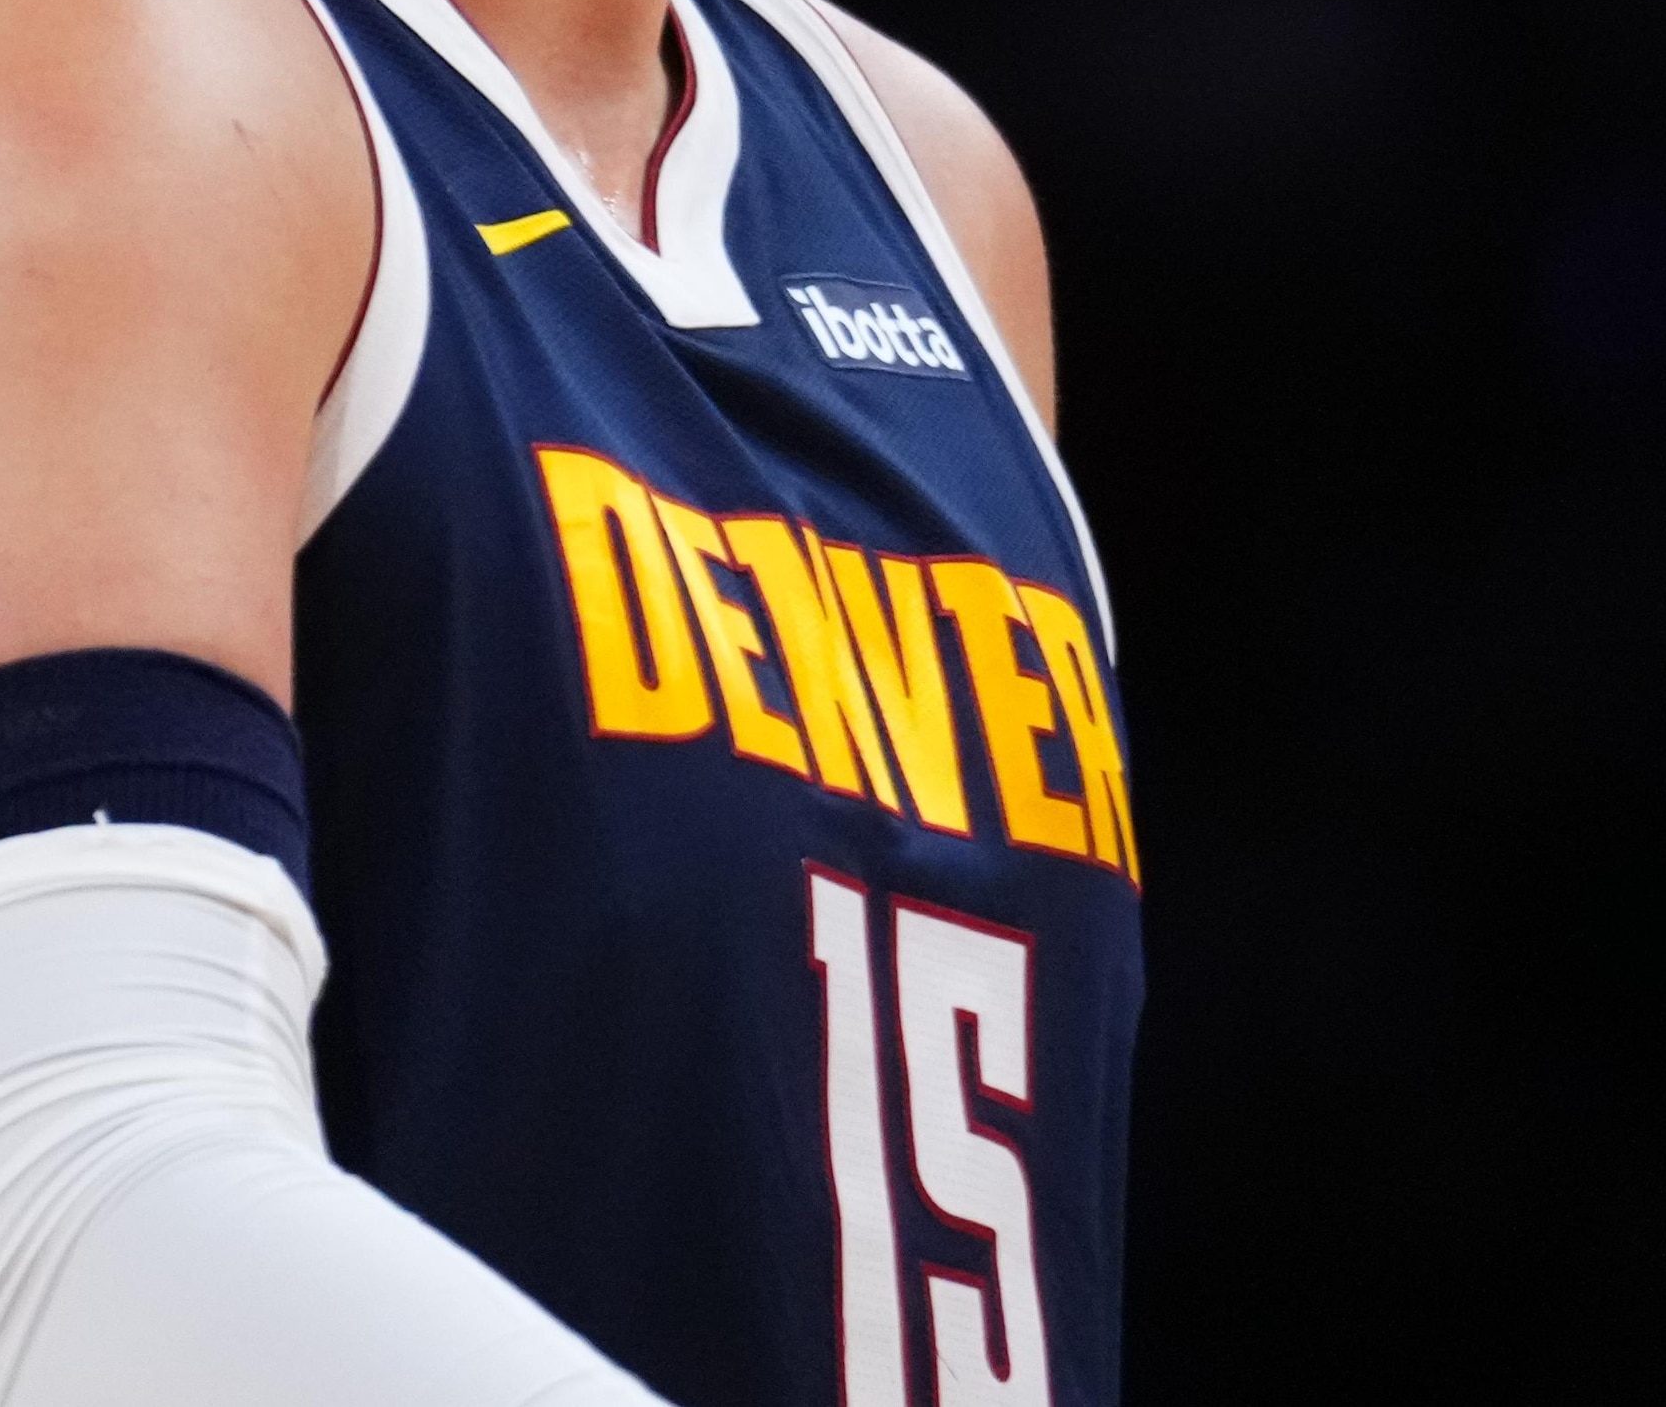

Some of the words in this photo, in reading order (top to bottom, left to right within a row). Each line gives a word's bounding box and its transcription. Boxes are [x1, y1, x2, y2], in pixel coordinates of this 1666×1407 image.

[786, 285, 966, 371] ibotta
[532, 442, 1142, 896] DENVER
[802, 858, 1055, 1407] 15
